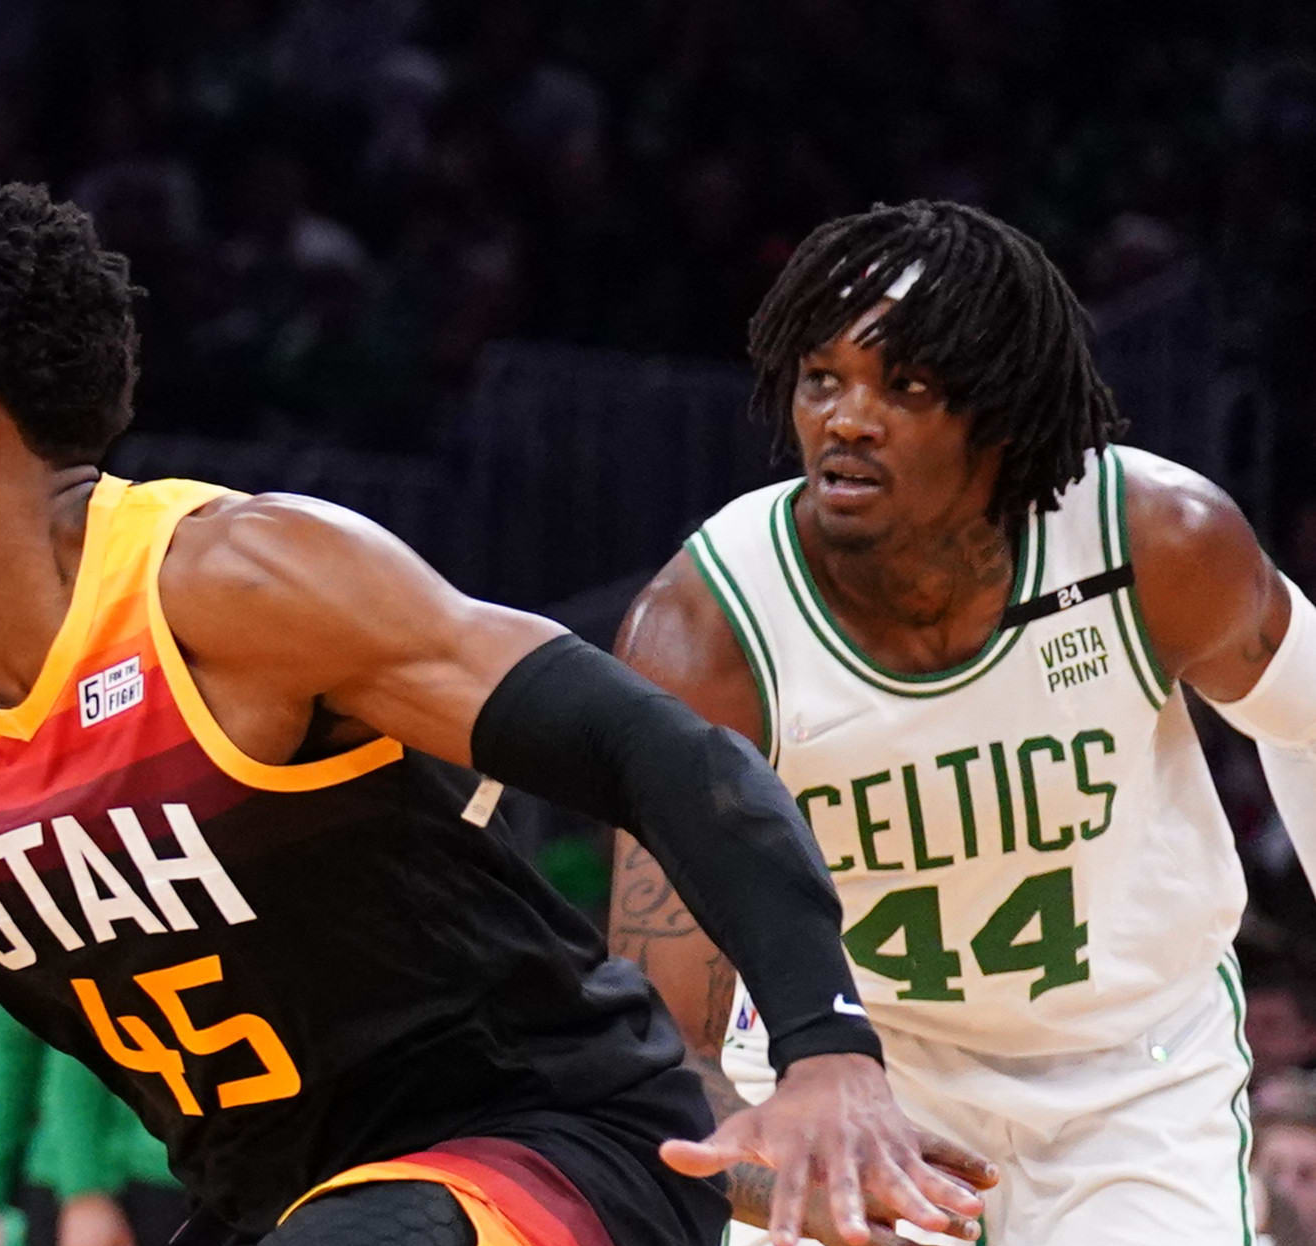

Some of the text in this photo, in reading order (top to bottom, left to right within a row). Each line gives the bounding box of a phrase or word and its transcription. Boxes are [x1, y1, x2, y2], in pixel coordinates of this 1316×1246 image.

[1056, 583, 1084, 610] 24
[1040, 626, 1106, 669] VISTA
[1047, 653, 1108, 693] PRINT
[84, 680, 100, 720] 5
[795, 728, 1117, 873] CELTICS
[840, 867, 1090, 1002] 44
[70, 954, 302, 1117] 45
